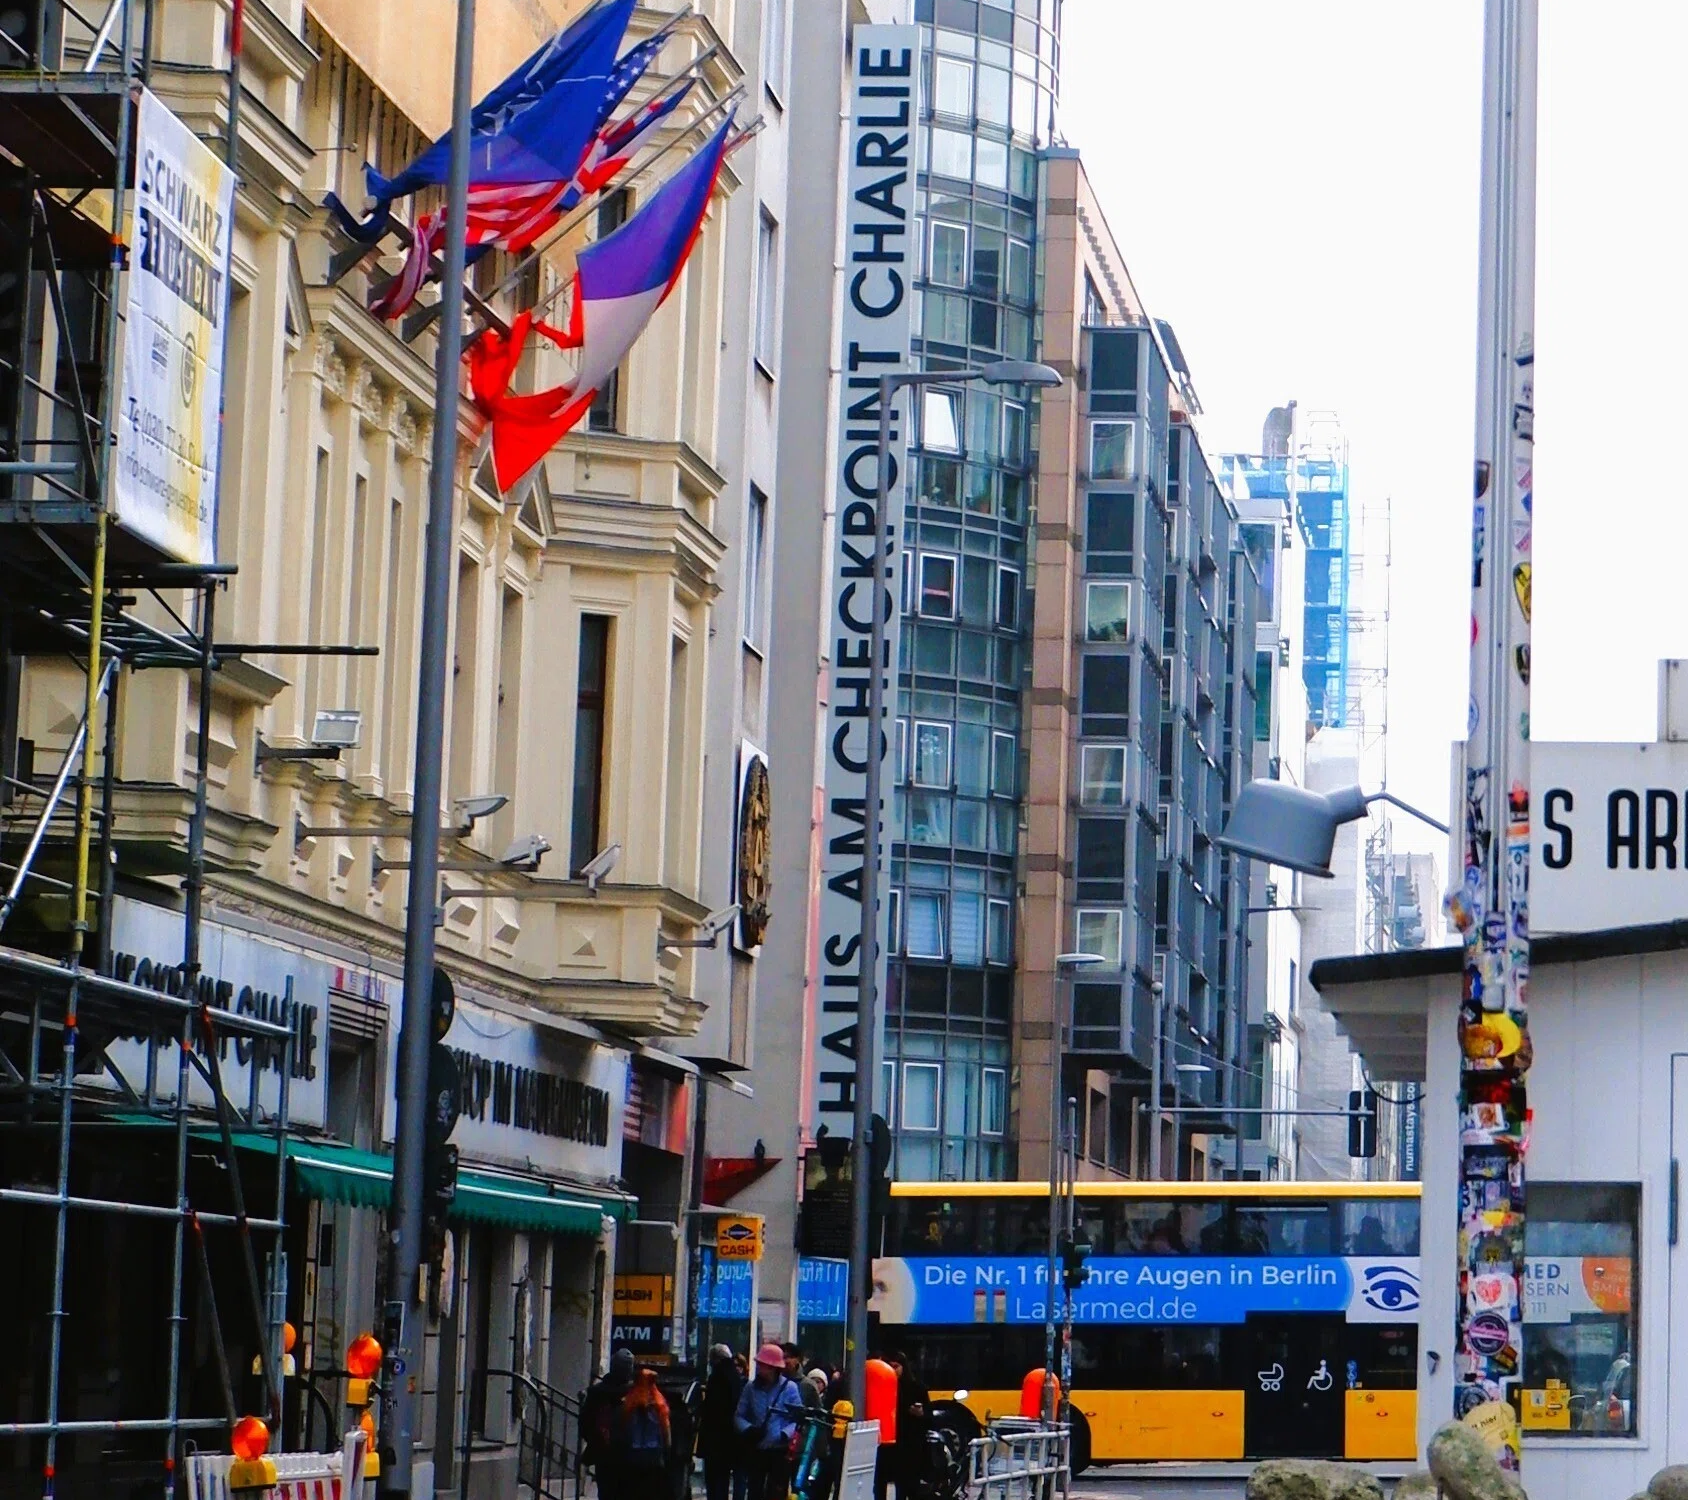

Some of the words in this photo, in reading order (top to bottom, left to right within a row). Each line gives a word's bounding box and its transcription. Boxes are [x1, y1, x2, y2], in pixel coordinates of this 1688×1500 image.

[143, 149, 223, 257] SCHWARZ
[848, 44, 913, 320] CHARLIE
[832, 343, 901, 785] CHECKPOINT
[824, 797, 890, 906] AM
[1543, 788, 1574, 870] S
[1405, 1082, 1417, 1172] numastays.co
[720, 1244, 755, 1257] CASH
[924, 1265, 968, 1286] Die
[975, 1265, 1010, 1286] Nr.
[1018, 1265, 1028, 1285] 1
[1034, 1264, 1058, 1286] fü
[1084, 1265, 1130, 1286] hre
[1137, 1264, 1222, 1291] Augen
[1230, 1264, 1253, 1286] in
[1262, 1263, 1338, 1286] Berlin
[613, 1289, 653, 1301] CASH
[1015, 1298, 1198, 1320] Lasermed.de
[1526, 1282, 1570, 1297] SERN
[613, 1325, 651, 1342] ATM
